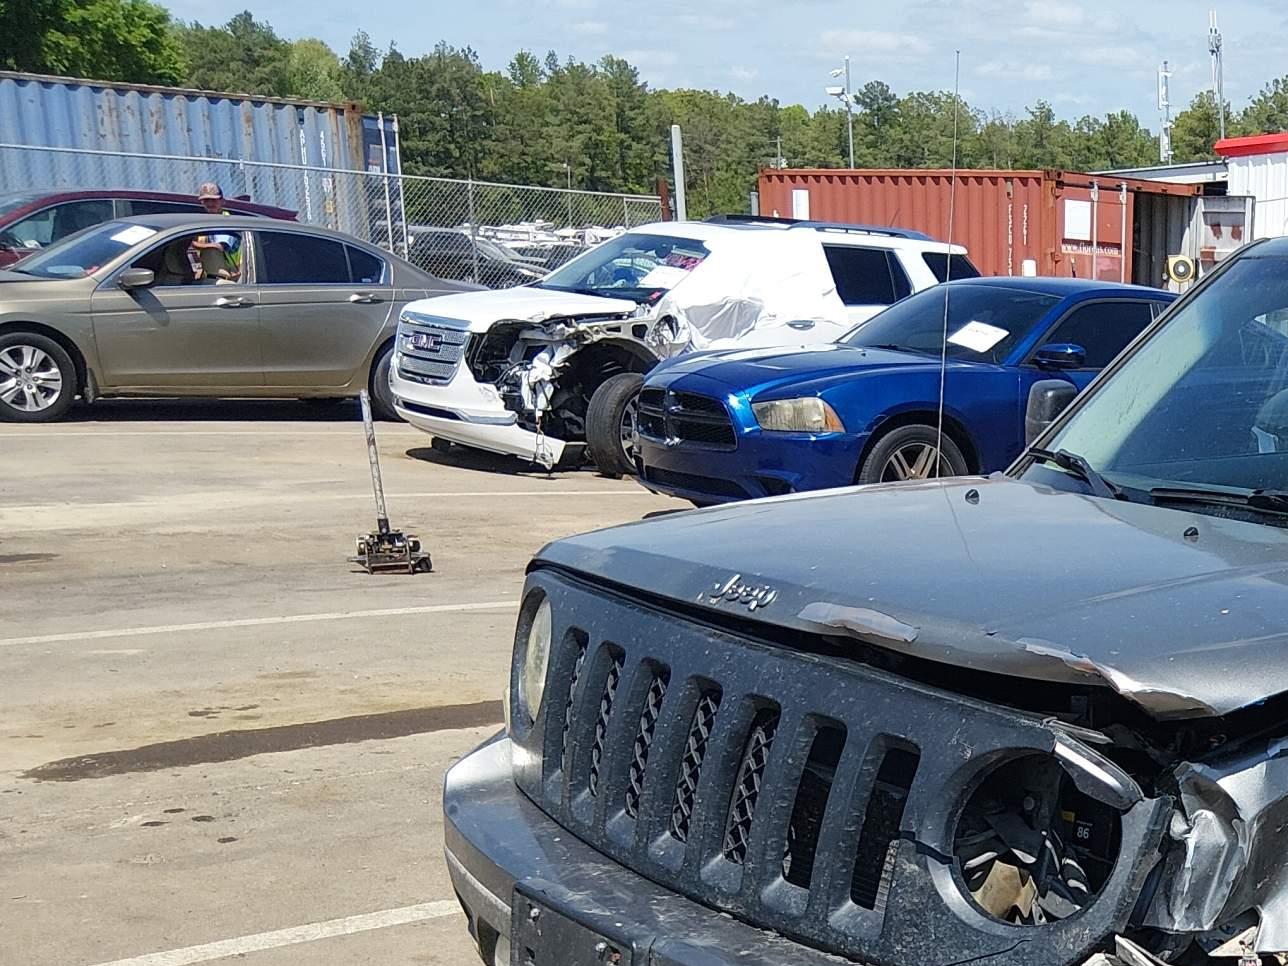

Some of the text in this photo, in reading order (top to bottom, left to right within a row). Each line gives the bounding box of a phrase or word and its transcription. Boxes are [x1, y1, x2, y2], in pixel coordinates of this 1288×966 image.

[411, 334, 441, 350] GMC
[709, 573, 777, 610] Jeep
[1077, 826, 1090, 839] 86
